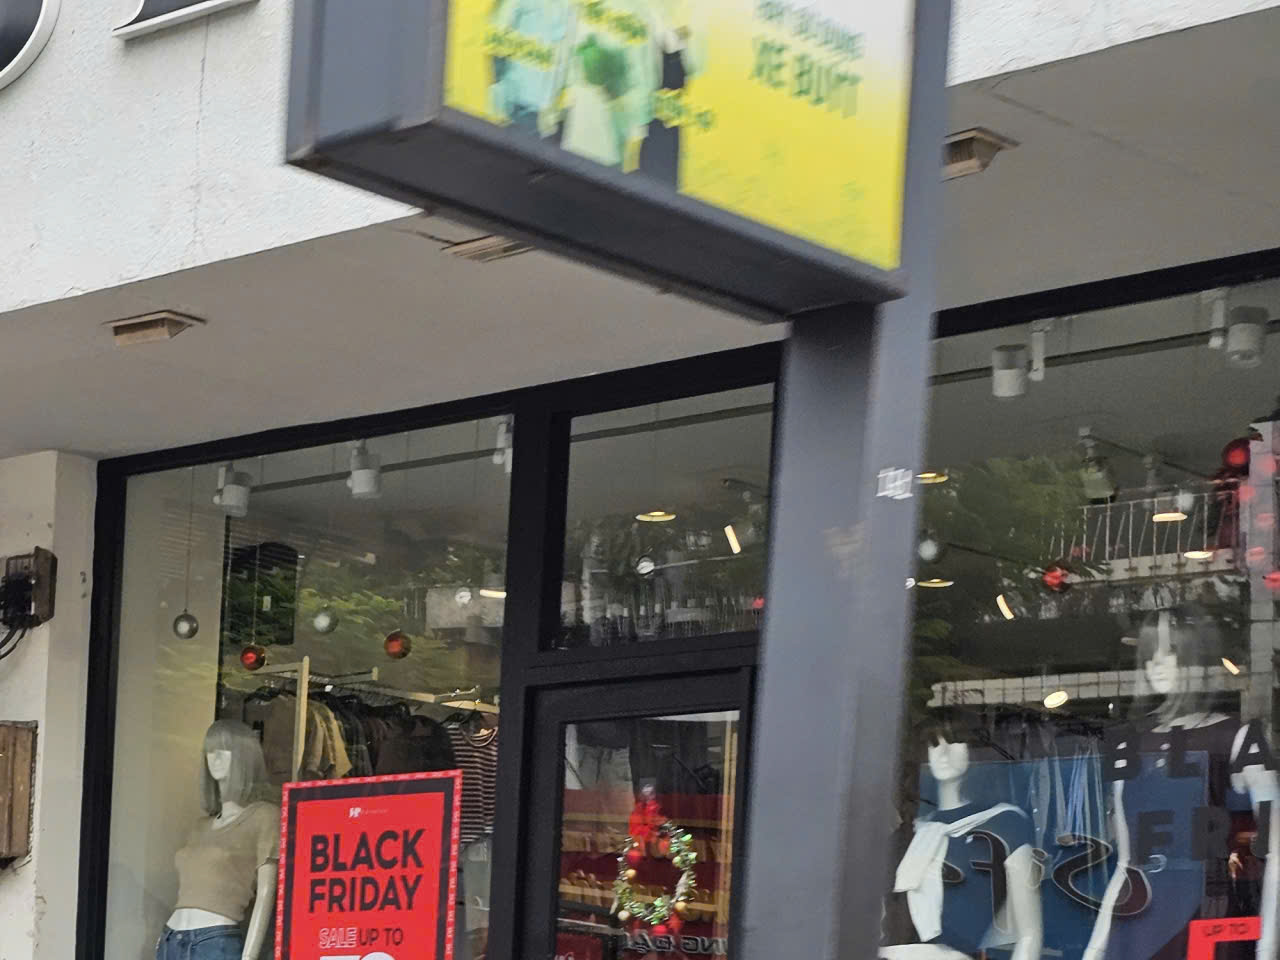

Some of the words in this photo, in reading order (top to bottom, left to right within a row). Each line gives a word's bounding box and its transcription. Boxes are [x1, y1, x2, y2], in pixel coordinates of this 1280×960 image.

[309, 828, 426, 873] BLACK
[307, 874, 423, 914] FRIDAY
[319, 927, 358, 949] SALE
[358, 928, 380, 947] UP
[384, 927, 405, 947] TO
